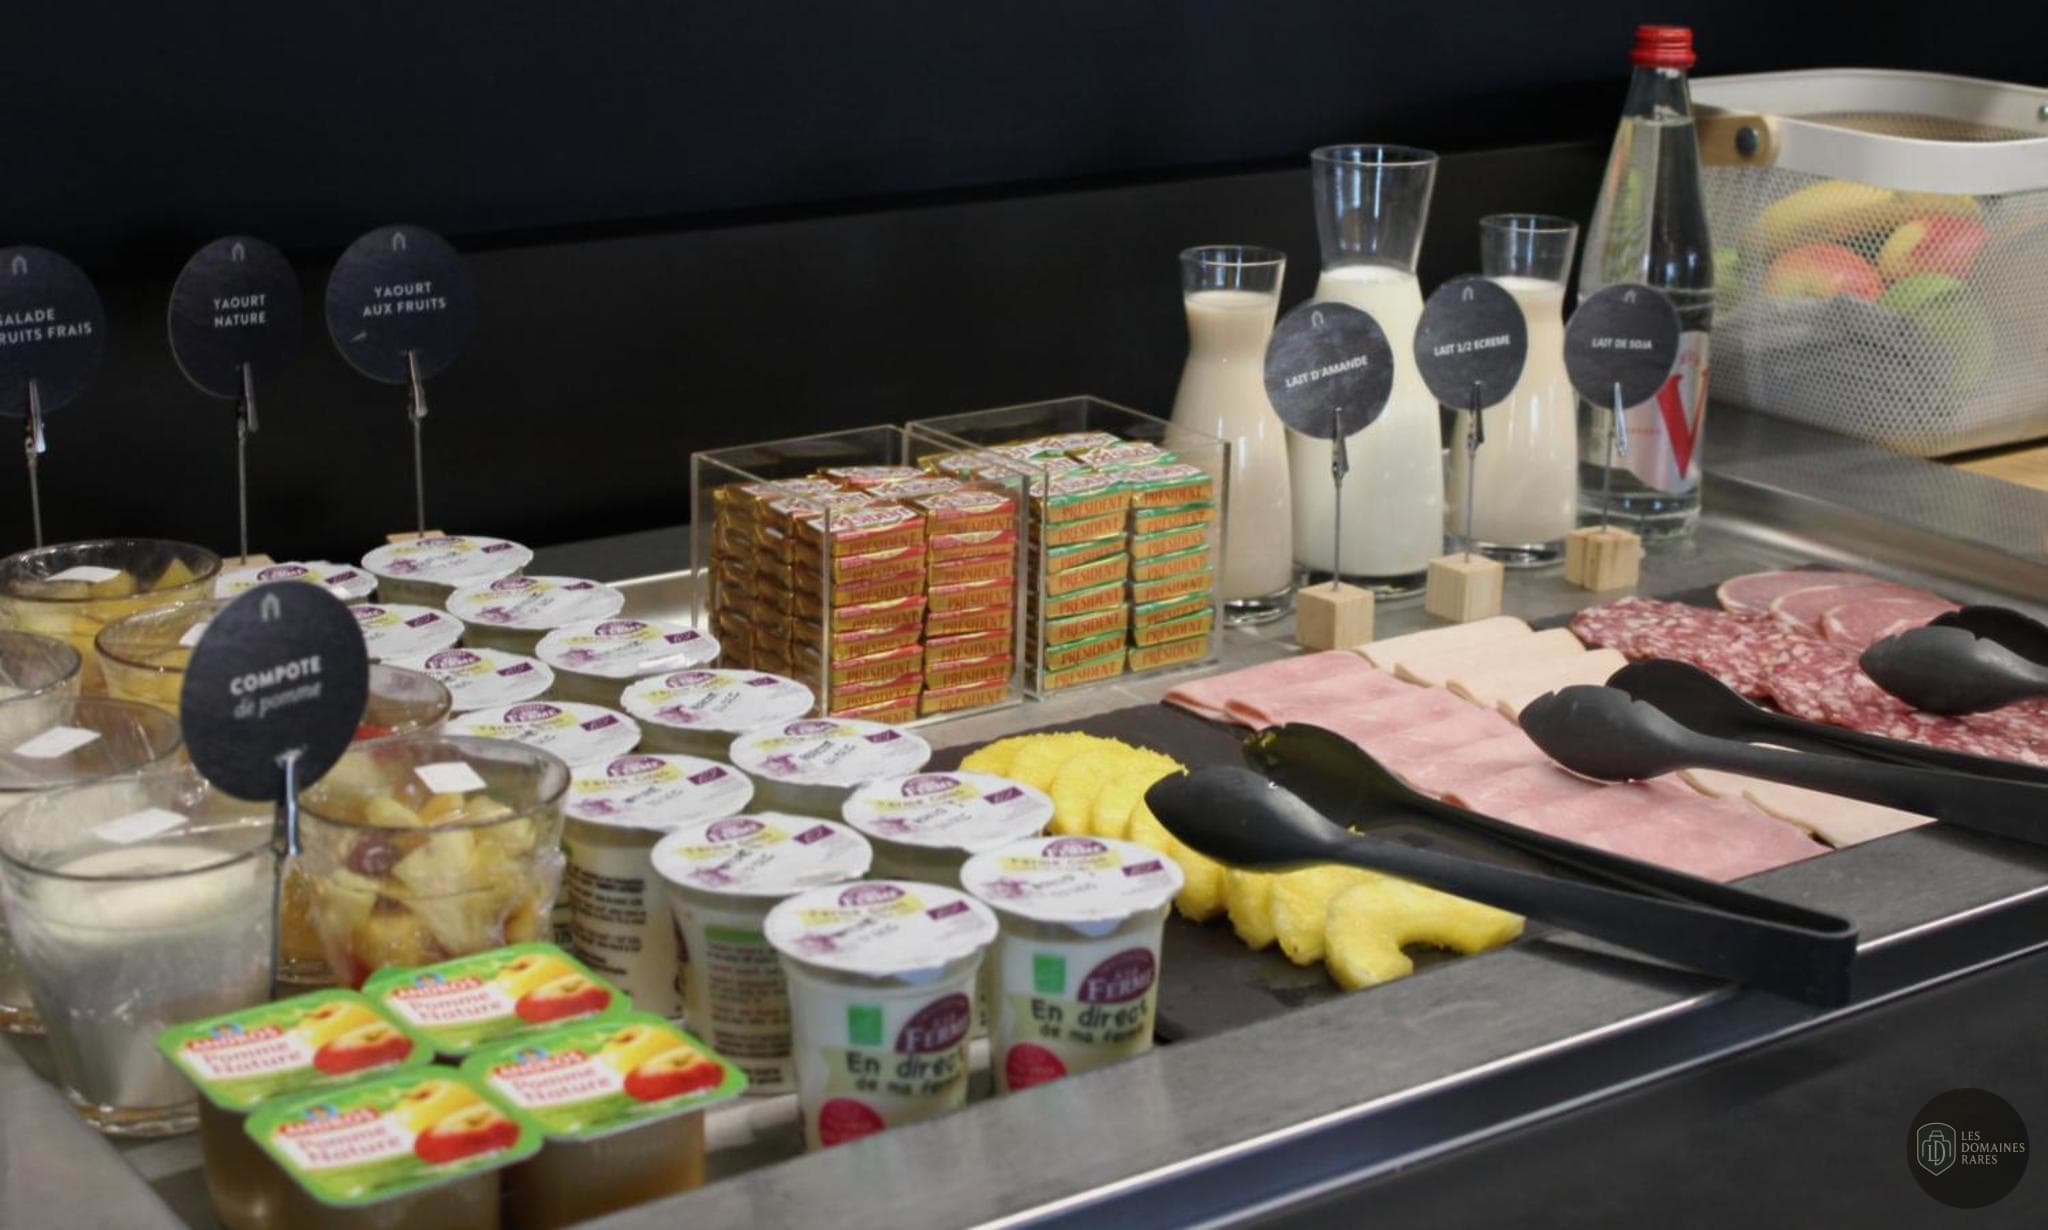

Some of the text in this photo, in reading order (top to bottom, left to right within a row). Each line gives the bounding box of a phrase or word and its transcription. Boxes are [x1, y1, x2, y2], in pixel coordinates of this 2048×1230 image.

[374, 281, 432, 298] YAOURT
[213, 293, 266, 310] YAOURT
[363, 297, 447, 317] AUX FRUITS
[214, 311, 266, 328] NATURE
[48, 321, 92, 339] FRAIS
[1433, 344, 1455, 357] LAIT
[1457, 342, 1472, 354] 1/2
[1592, 338, 1612, 349] LAIT
[1614, 339, 1627, 349] DE
[1285, 355, 1369, 388] LAIT D'AMANDE
[230, 655, 323, 697] COMPOTE
[233, 697, 255, 720] de
[1031, 999, 1148, 1028] En direct
[846, 1050, 960, 1078] En direc
